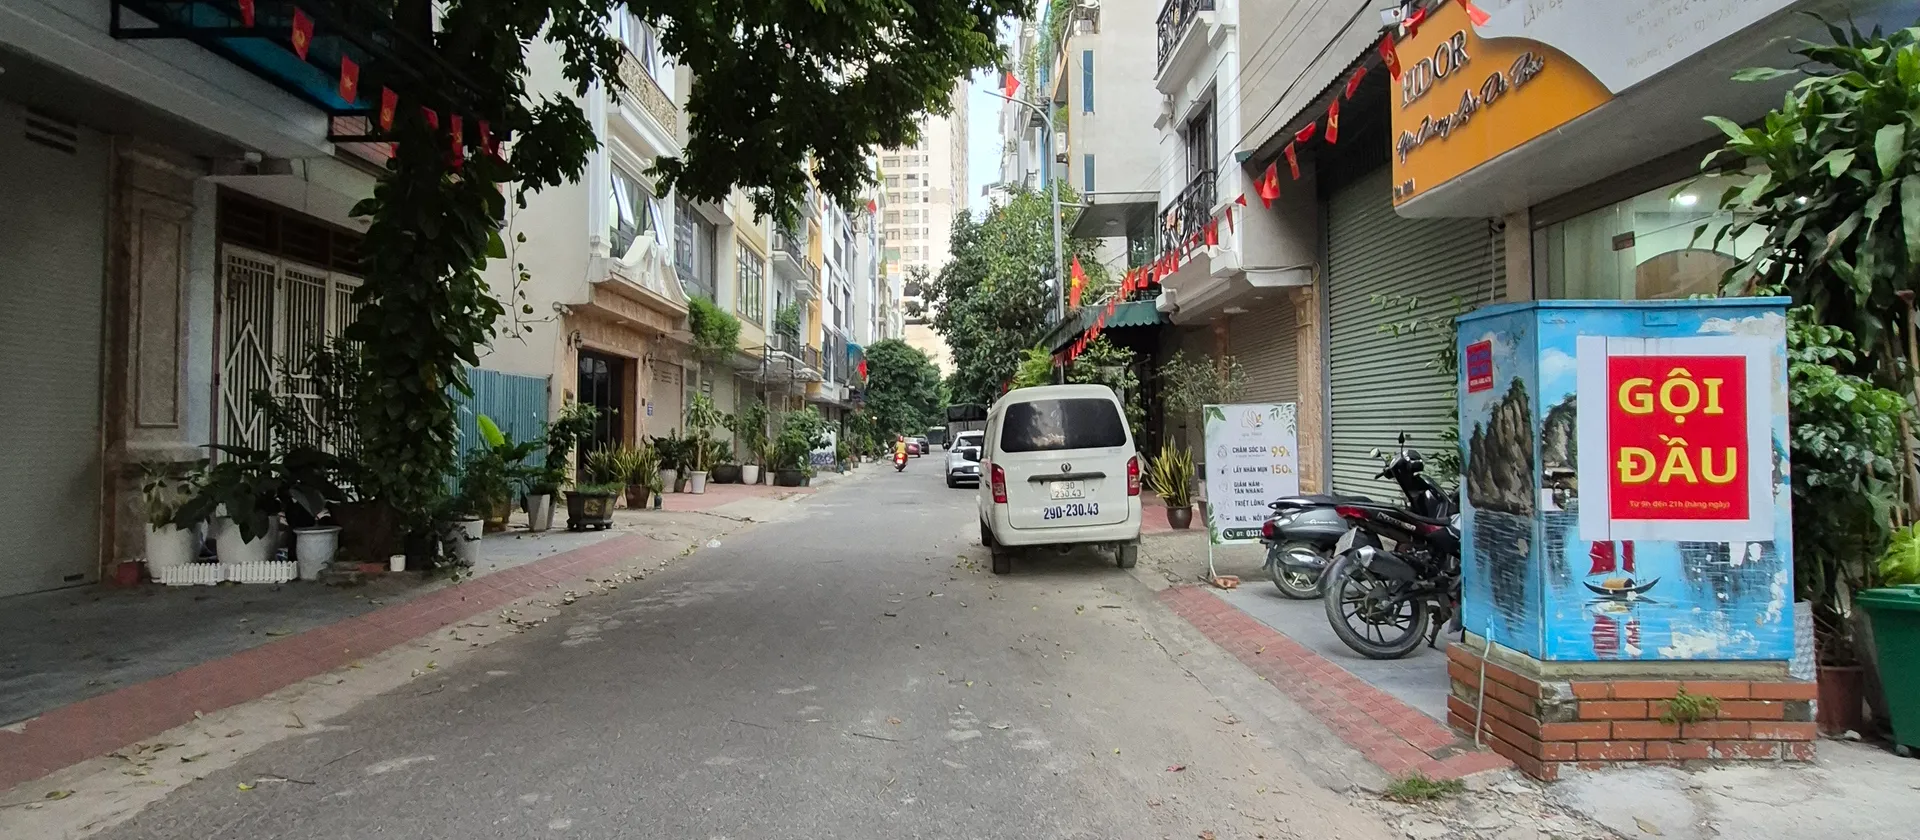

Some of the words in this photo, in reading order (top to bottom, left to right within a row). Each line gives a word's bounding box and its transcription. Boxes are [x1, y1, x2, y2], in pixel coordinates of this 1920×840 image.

[1618, 367, 1724, 424] GỘI
[1617, 434, 1738, 484] ĐẦU
[1055, 489, 1082, 498] 230.43
[1043, 503, 1099, 520] 29D-230.43
[1668, 500, 1683, 508] 21h
